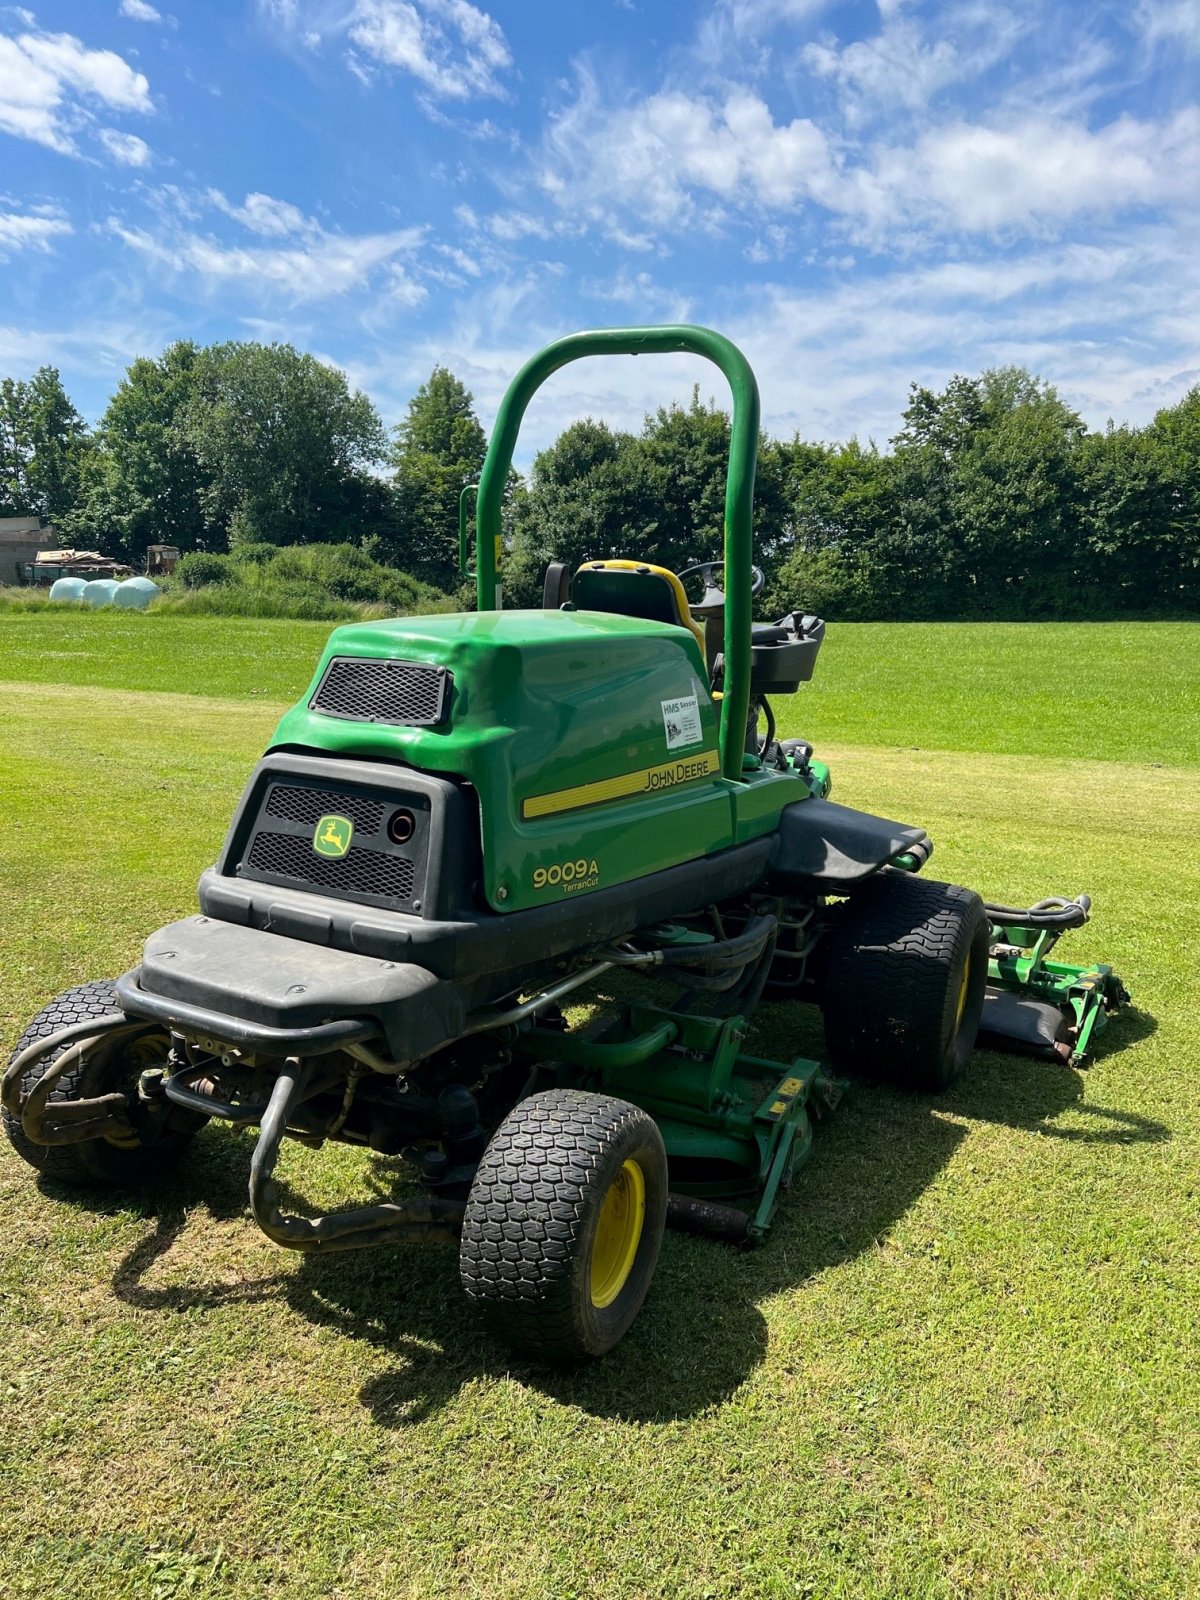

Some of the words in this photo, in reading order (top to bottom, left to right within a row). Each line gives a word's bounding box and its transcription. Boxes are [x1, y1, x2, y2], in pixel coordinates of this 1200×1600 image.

[663, 702, 680, 715] HMS
[645, 769, 675, 790] JOHN
[676, 760, 709, 780] DEERE
[533, 859, 599, 888] 9009A
[563, 877, 599, 893] TerrainCut
